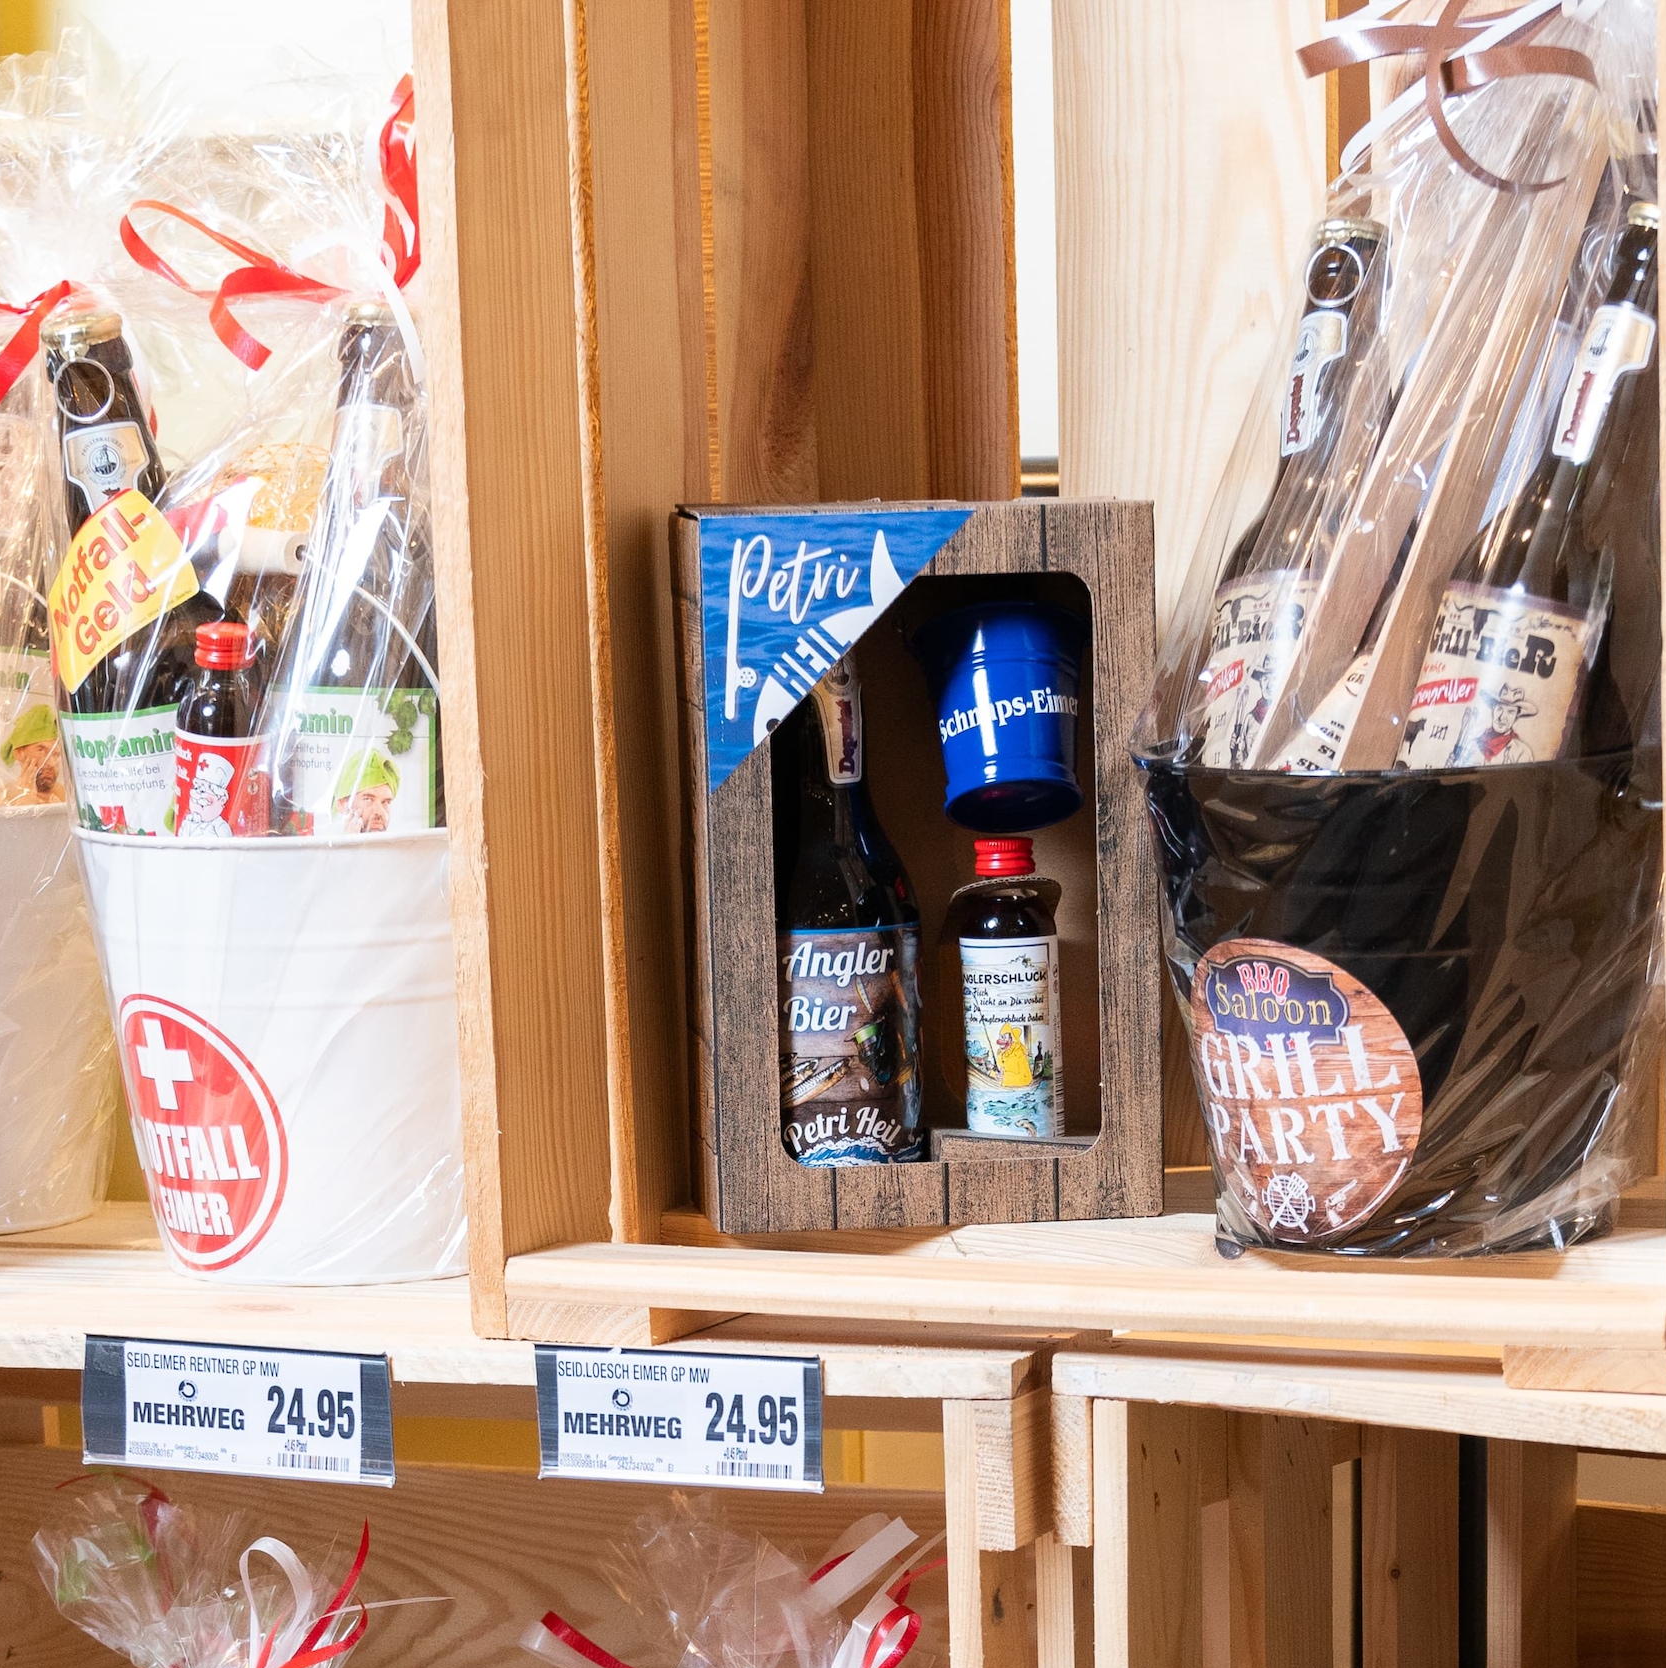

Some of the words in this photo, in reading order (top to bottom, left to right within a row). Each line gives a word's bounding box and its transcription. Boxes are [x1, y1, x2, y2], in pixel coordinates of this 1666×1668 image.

[54, 509, 149, 642] Notfall-
[729, 534, 860, 626] Petri
[74, 560, 157, 658] Geld
[145, 764, 160, 774] bei
[782, 941, 894, 988] Angler
[1236, 962, 1290, 1005] BBQ
[783, 998, 857, 1031] Bier
[1215, 982, 1333, 1027] Saloon
[1201, 1024, 1400, 1100] GRILL
[783, 1106, 849, 1153] Petri
[855, 1106, 901, 1146] Heil
[1210, 1092, 1406, 1165] PARTY
[127, 1352, 186, 1371] SEID.EIMER
[190, 1356, 239, 1374] RENTNER
[243, 1360, 256, 1376] GP
[260, 1361, 279, 1377] MW
[558, 1361, 629, 1380] SEID.LOESCH
[633, 1364, 668, 1382] EIMER
[671, 1366, 686, 1383] GP
[689, 1367, 710, 1384] MW
[133, 1402, 245, 1431] MEHRWEG
[267, 1385, 355, 1439] 24.95
[563, 1411, 682, 1440] MEHRWEG
[705, 1392, 798, 1446] 24.95
